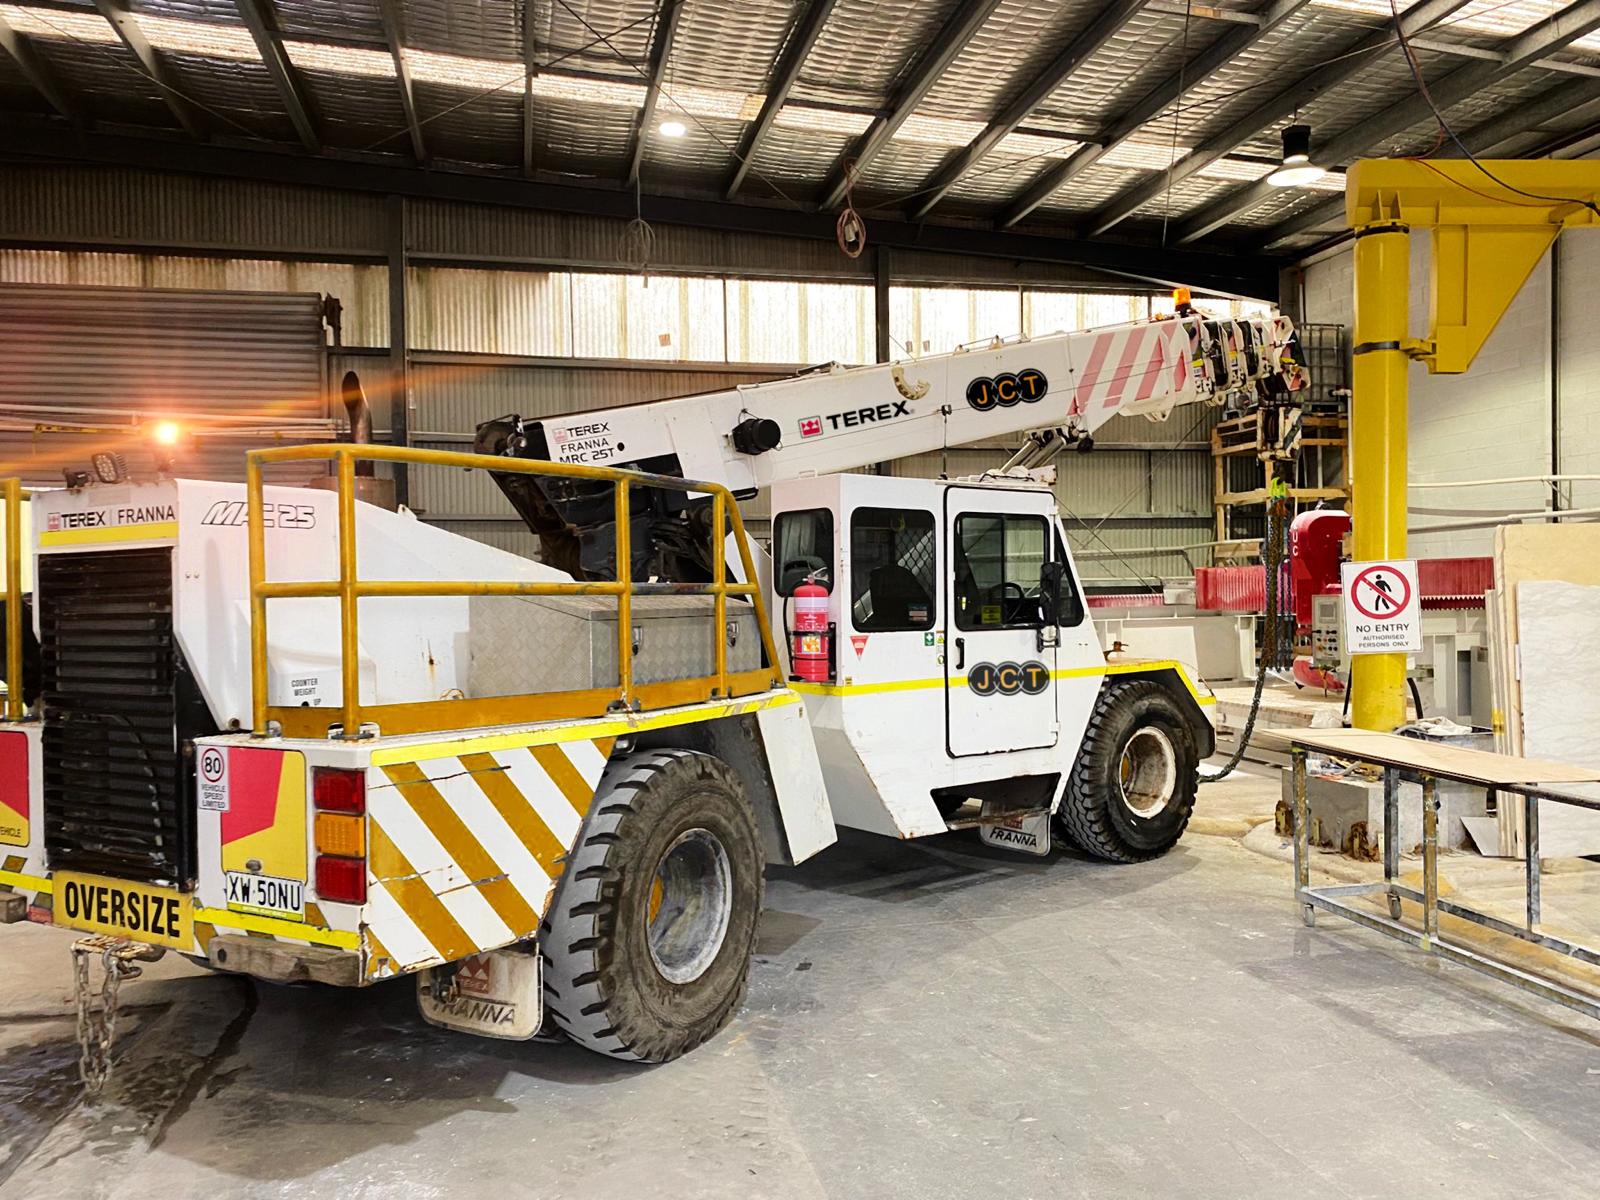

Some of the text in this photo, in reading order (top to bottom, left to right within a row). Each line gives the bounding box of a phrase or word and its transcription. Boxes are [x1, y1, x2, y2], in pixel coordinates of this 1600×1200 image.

[976, 375, 1039, 405] JCT
[826, 400, 910, 430] TEREX
[566, 422, 610, 437] TEREX
[560, 438, 609, 453] FRANNA
[559, 447, 614, 463] MRC 25T
[61, 505, 176, 529] TEREX FRANNA
[277, 503, 317, 529] 25
[1355, 623, 1410, 633] NO ENTRY
[291, 678, 318, 687] COUNTER
[977, 668, 1042, 690] JCT
[294, 687, 316, 696] WEIGHT
[204, 756, 221, 774] 80
[0, 826, 21, 838] EHICLE
[989, 827, 1037, 847] FRANNA
[65, 881, 180, 938] OVERSIZE
